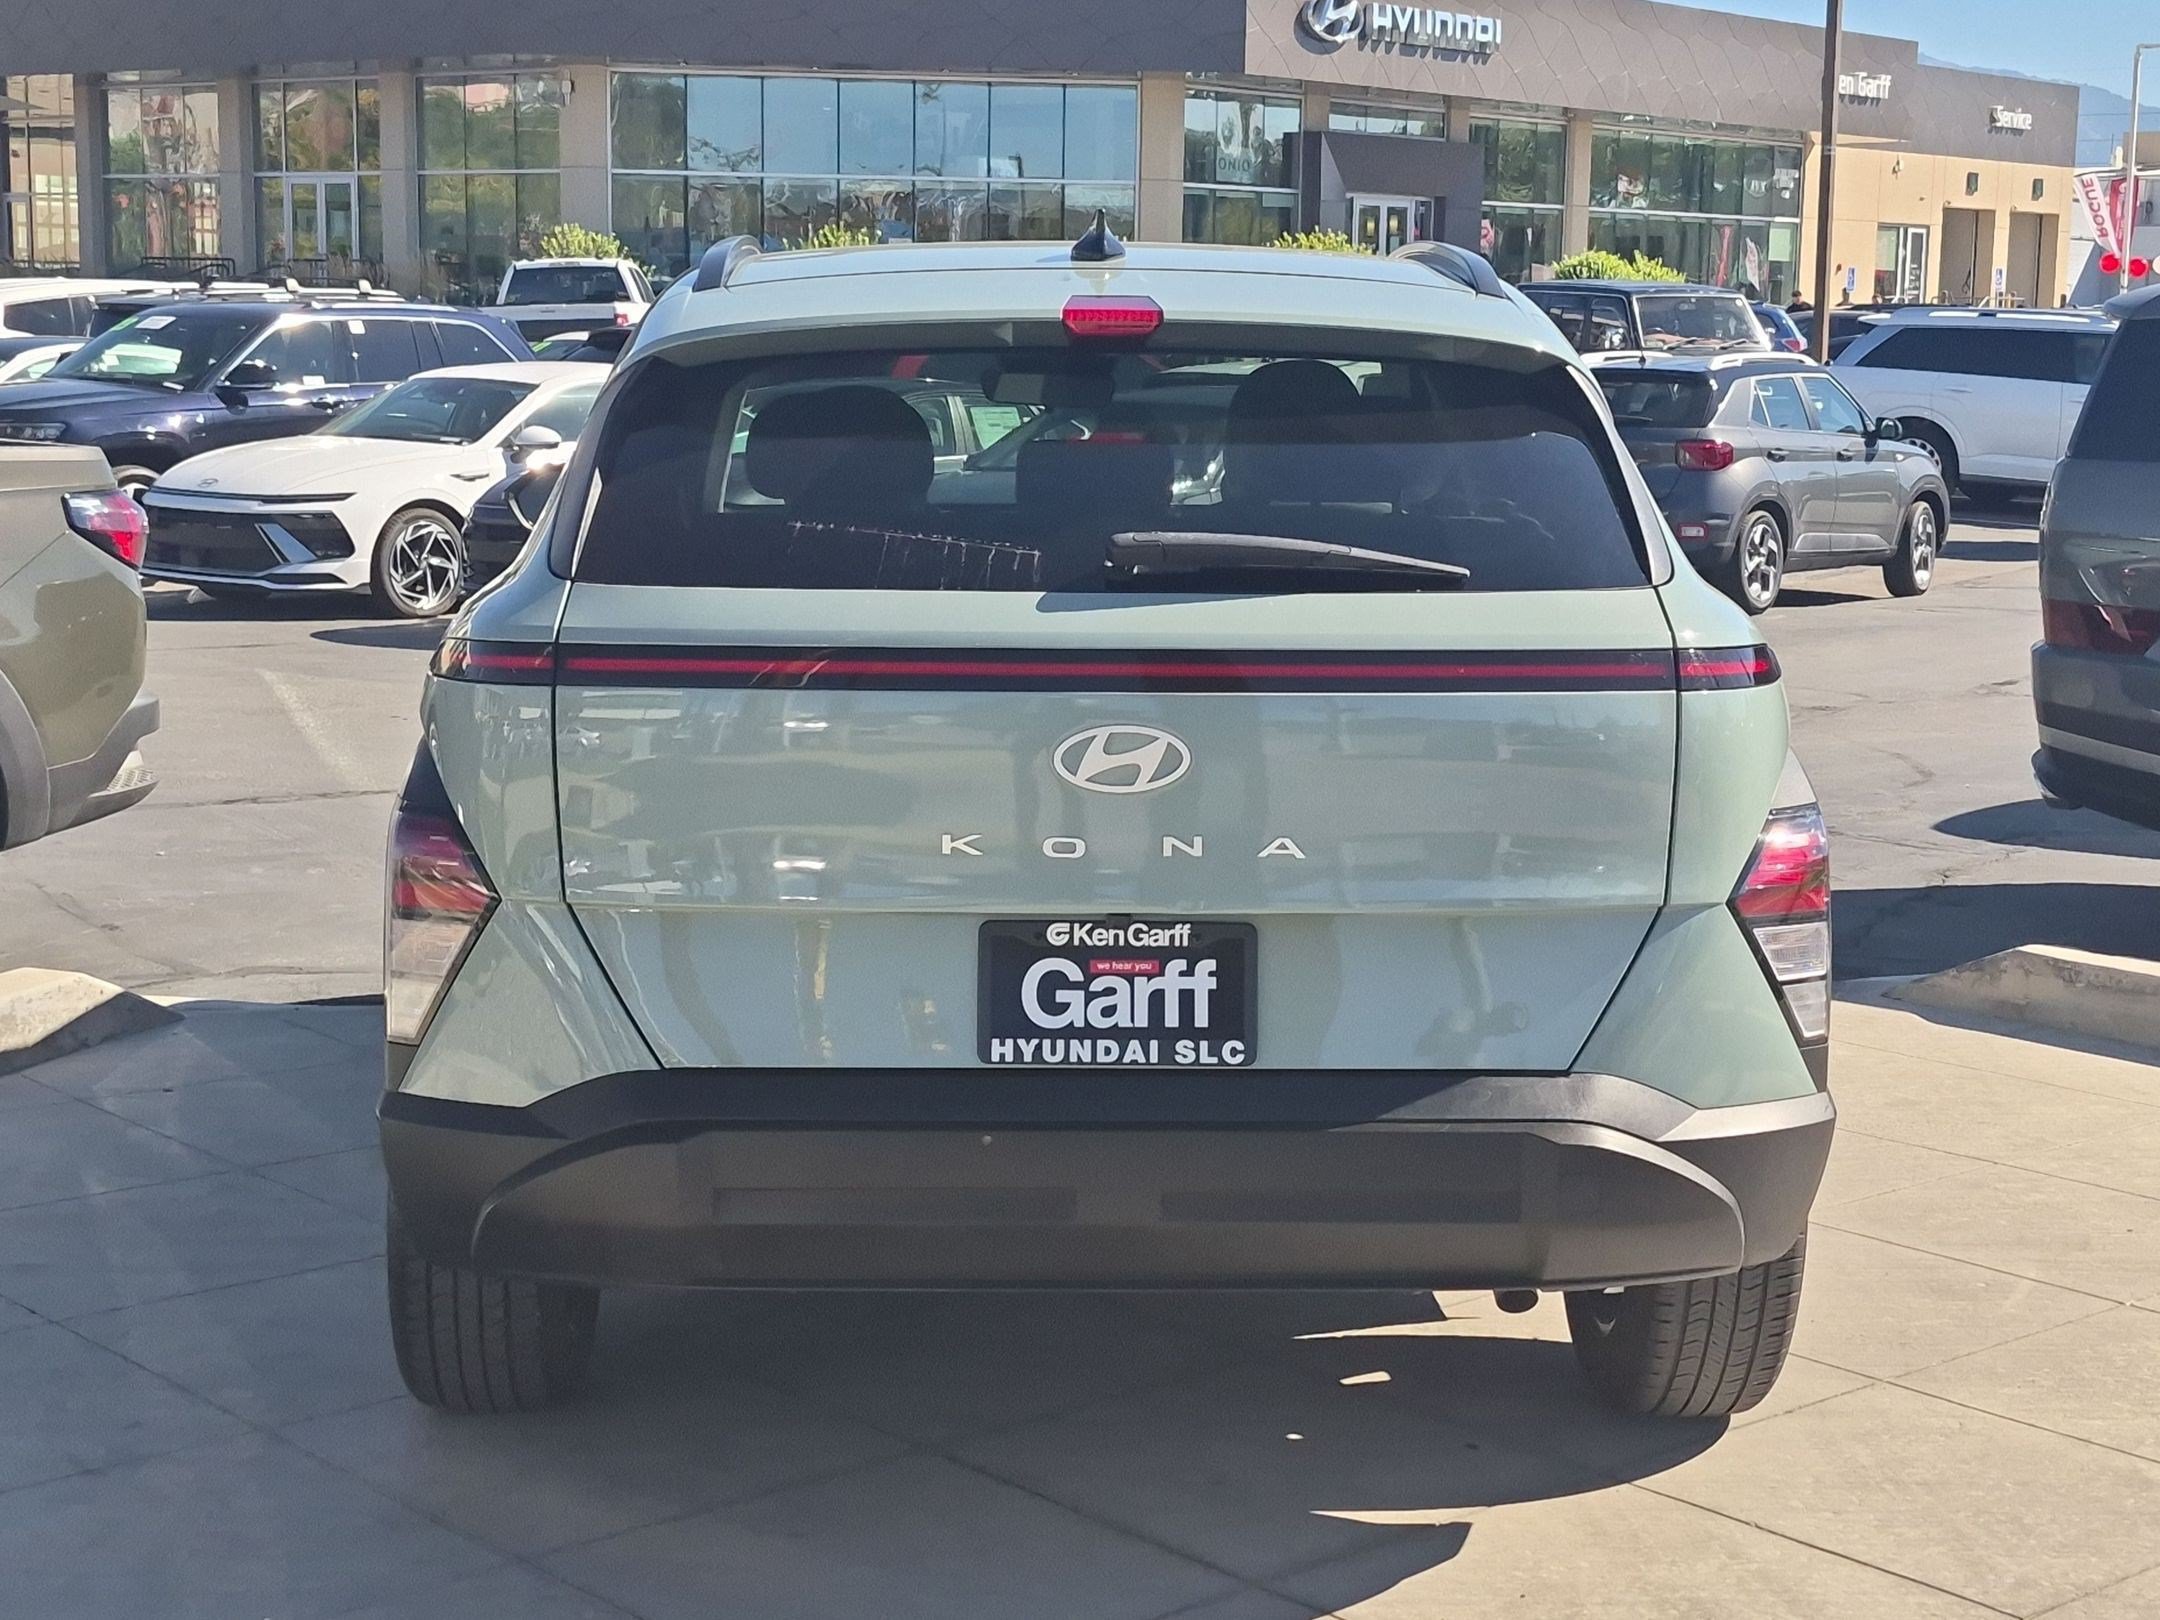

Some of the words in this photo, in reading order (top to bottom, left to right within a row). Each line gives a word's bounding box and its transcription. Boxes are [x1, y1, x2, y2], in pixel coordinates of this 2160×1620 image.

[1371, 2, 1502, 49] HYUNDAI
[1838, 73, 1854, 96] en
[1854, 71, 1892, 99] Garff
[1991, 105, 2033, 131] Service
[941, 833, 1306, 859] KONA
[1073, 922, 1125, 946] Ken
[1126, 922, 1191, 947] Garff
[1096, 962, 1111, 971] we
[1112, 960, 1132, 971] hear
[1135, 962, 1152, 973] you
[1021, 957, 1217, 1029] Garff
[990, 1038, 1159, 1064] HYUNDAI
[1174, 1039, 1246, 1065] SLC
